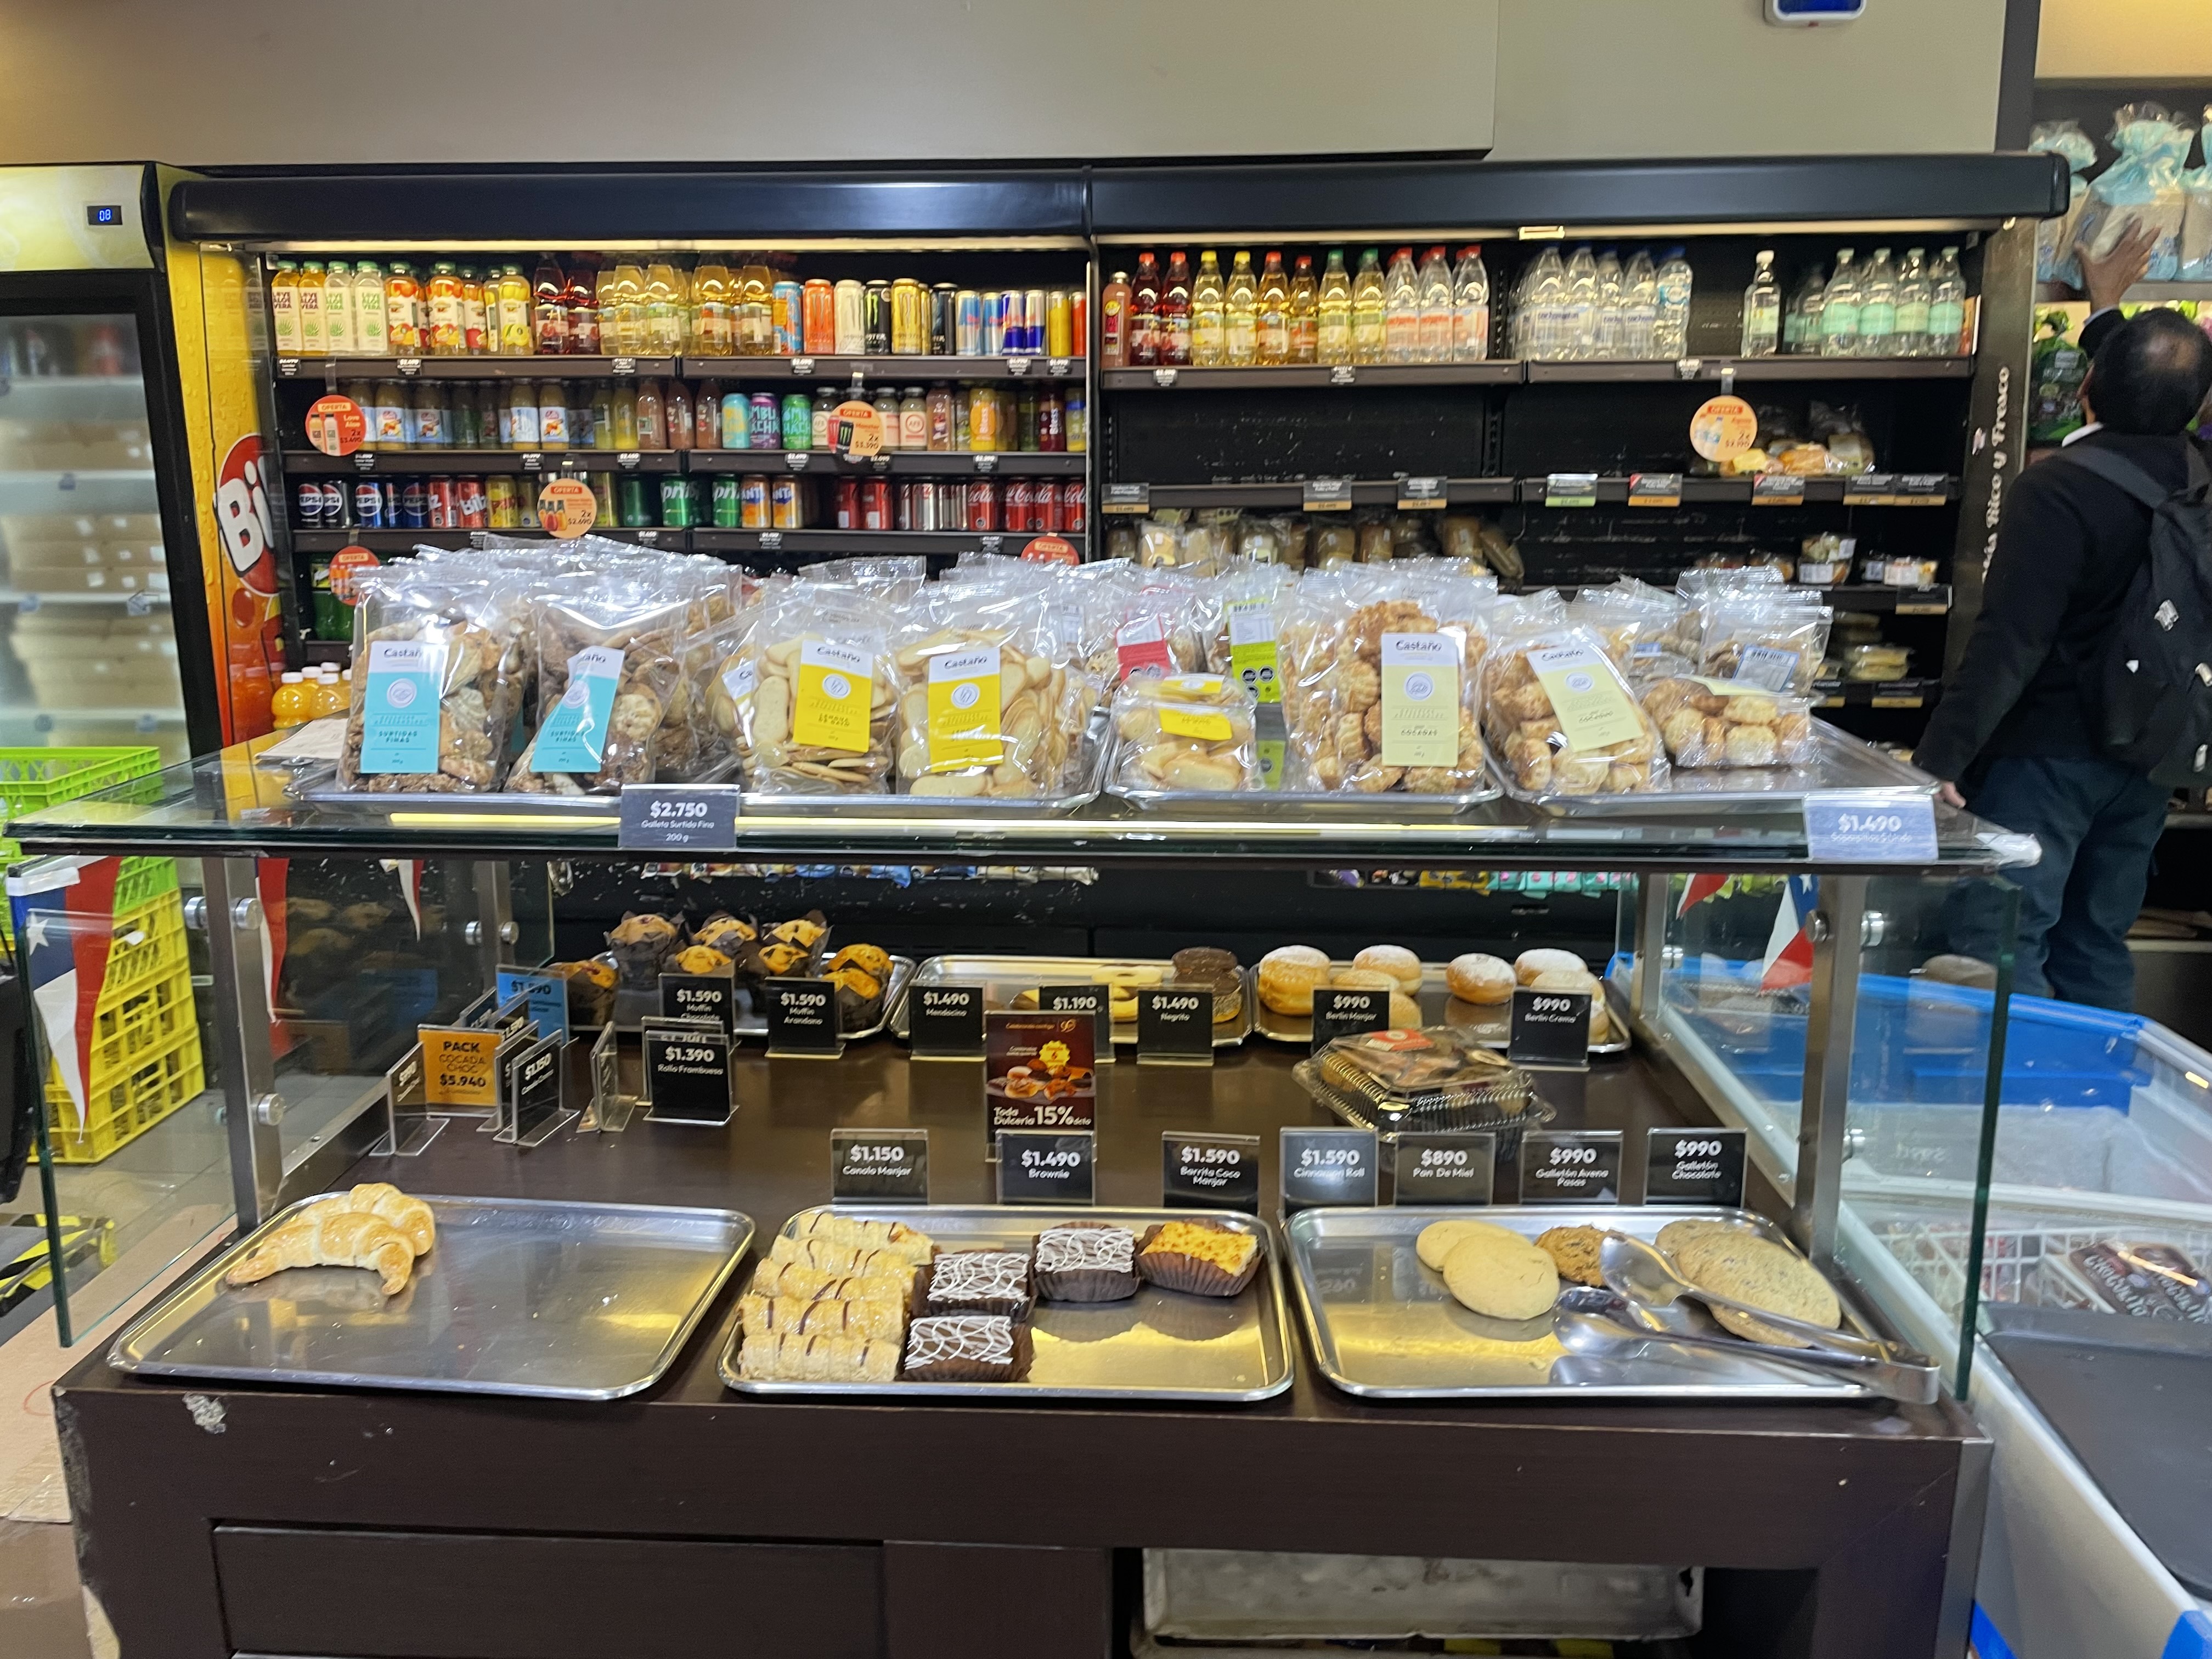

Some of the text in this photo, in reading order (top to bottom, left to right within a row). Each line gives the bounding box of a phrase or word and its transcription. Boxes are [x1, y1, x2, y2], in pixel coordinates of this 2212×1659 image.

[1991, 366, 2010, 447] Fresco
[1993, 450, 2007, 470] y
[1985, 473, 2002, 528] Rico
[1395, 640, 1442, 652] Castaño
[817, 646, 860, 663] Castaño
[944, 656, 988, 670] Castaño
[650, 800, 708, 819] $2.750
[1838, 812, 1902, 833] $1.490
[665, 833, 689, 843] 200 g
[676, 988, 723, 1003] $1.590
[780, 991, 826, 1007] $1.590
[923, 990, 970, 1006] $1.490
[1053, 995, 1097, 1011] $1.190
[1152, 994, 1199, 1010] $1.490
[1333, 994, 1370, 1010] $990
[1532, 995, 1572, 1012] $990
[1160, 1012, 1190, 1022] Negrito
[1325, 1011, 1347, 1021] Berlin
[1525, 1012, 1548, 1023] Berlin
[443, 1041, 479, 1053] PACK
[665, 1045, 715, 1062] $1.390
[439, 1053, 487, 1064] COCADA
[678, 1065, 724, 1075] Frambuesa
[439, 1073, 486, 1087] $5.940
[994, 1107, 1019, 1116] Toda
[1034, 1105, 1074, 1125] 15%
[850, 1144, 905, 1163] $1.150
[1181, 1146, 1240, 1165] $1.590
[1674, 1139, 1723, 1158] $990
[1020, 1149, 1081, 1167] $1.490
[1301, 1148, 1361, 1167] $1.590
[1420, 1149, 1468, 1167] $890
[1549, 1147, 1597, 1166] $990
[877, 1166, 912, 1177] Manjar
[1180, 1166, 1241, 1178] Barrita Coco
[1345, 1167, 1365, 1178] Roll
[1413, 1167, 1475, 1178] Pan De Miel
[1676, 1160, 1719, 1171] Galletón
[1028, 1168, 1070, 1179] Brownie
[1535, 1168, 1609, 1179] Galletón Avena
[1672, 1170, 1722, 1181] Chocolate
[1193, 1176, 1228, 1188] Manjar
[1556, 1178, 1586, 1187] Pasas
